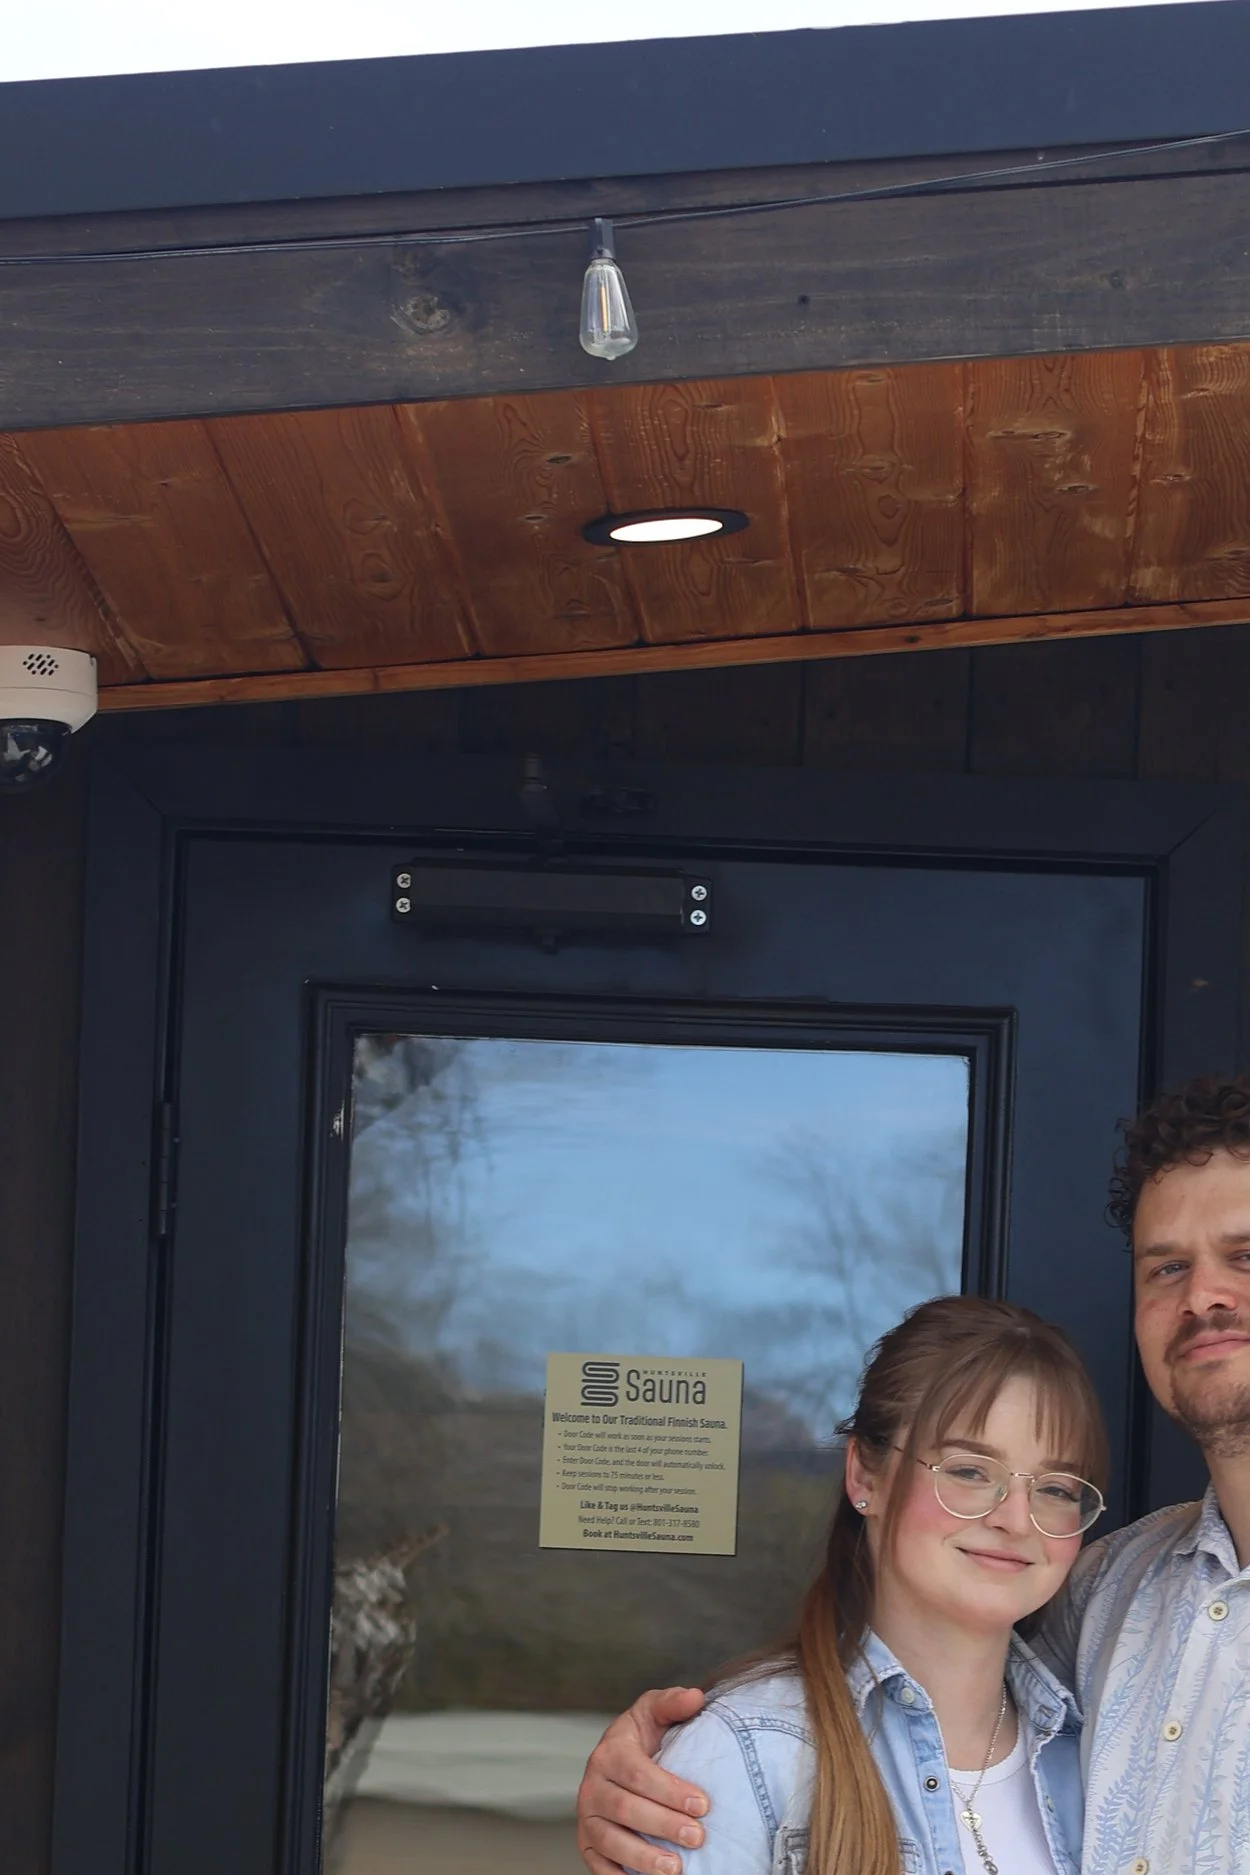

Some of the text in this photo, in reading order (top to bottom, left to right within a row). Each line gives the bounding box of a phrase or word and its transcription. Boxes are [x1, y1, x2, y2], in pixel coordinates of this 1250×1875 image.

[625, 1369, 707, 1405] Sauna
[551, 1412, 590, 1423] Welcome
[591, 1414, 600, 1423] to
[602, 1414, 618, 1424] Our
[619, 1415, 665, 1426] Traditional
[667, 1416, 698, 1427] Finnish
[580, 1500, 596, 1509] Like
[596, 1501, 603, 1509] &
[604, 1501, 618, 1512] Tag
[629, 1503, 698, 1513] @HuntsvilleSauna
[582, 1528, 602, 1537] Book
[613, 1530, 693, 1541] HuntsvilleSauna.com
